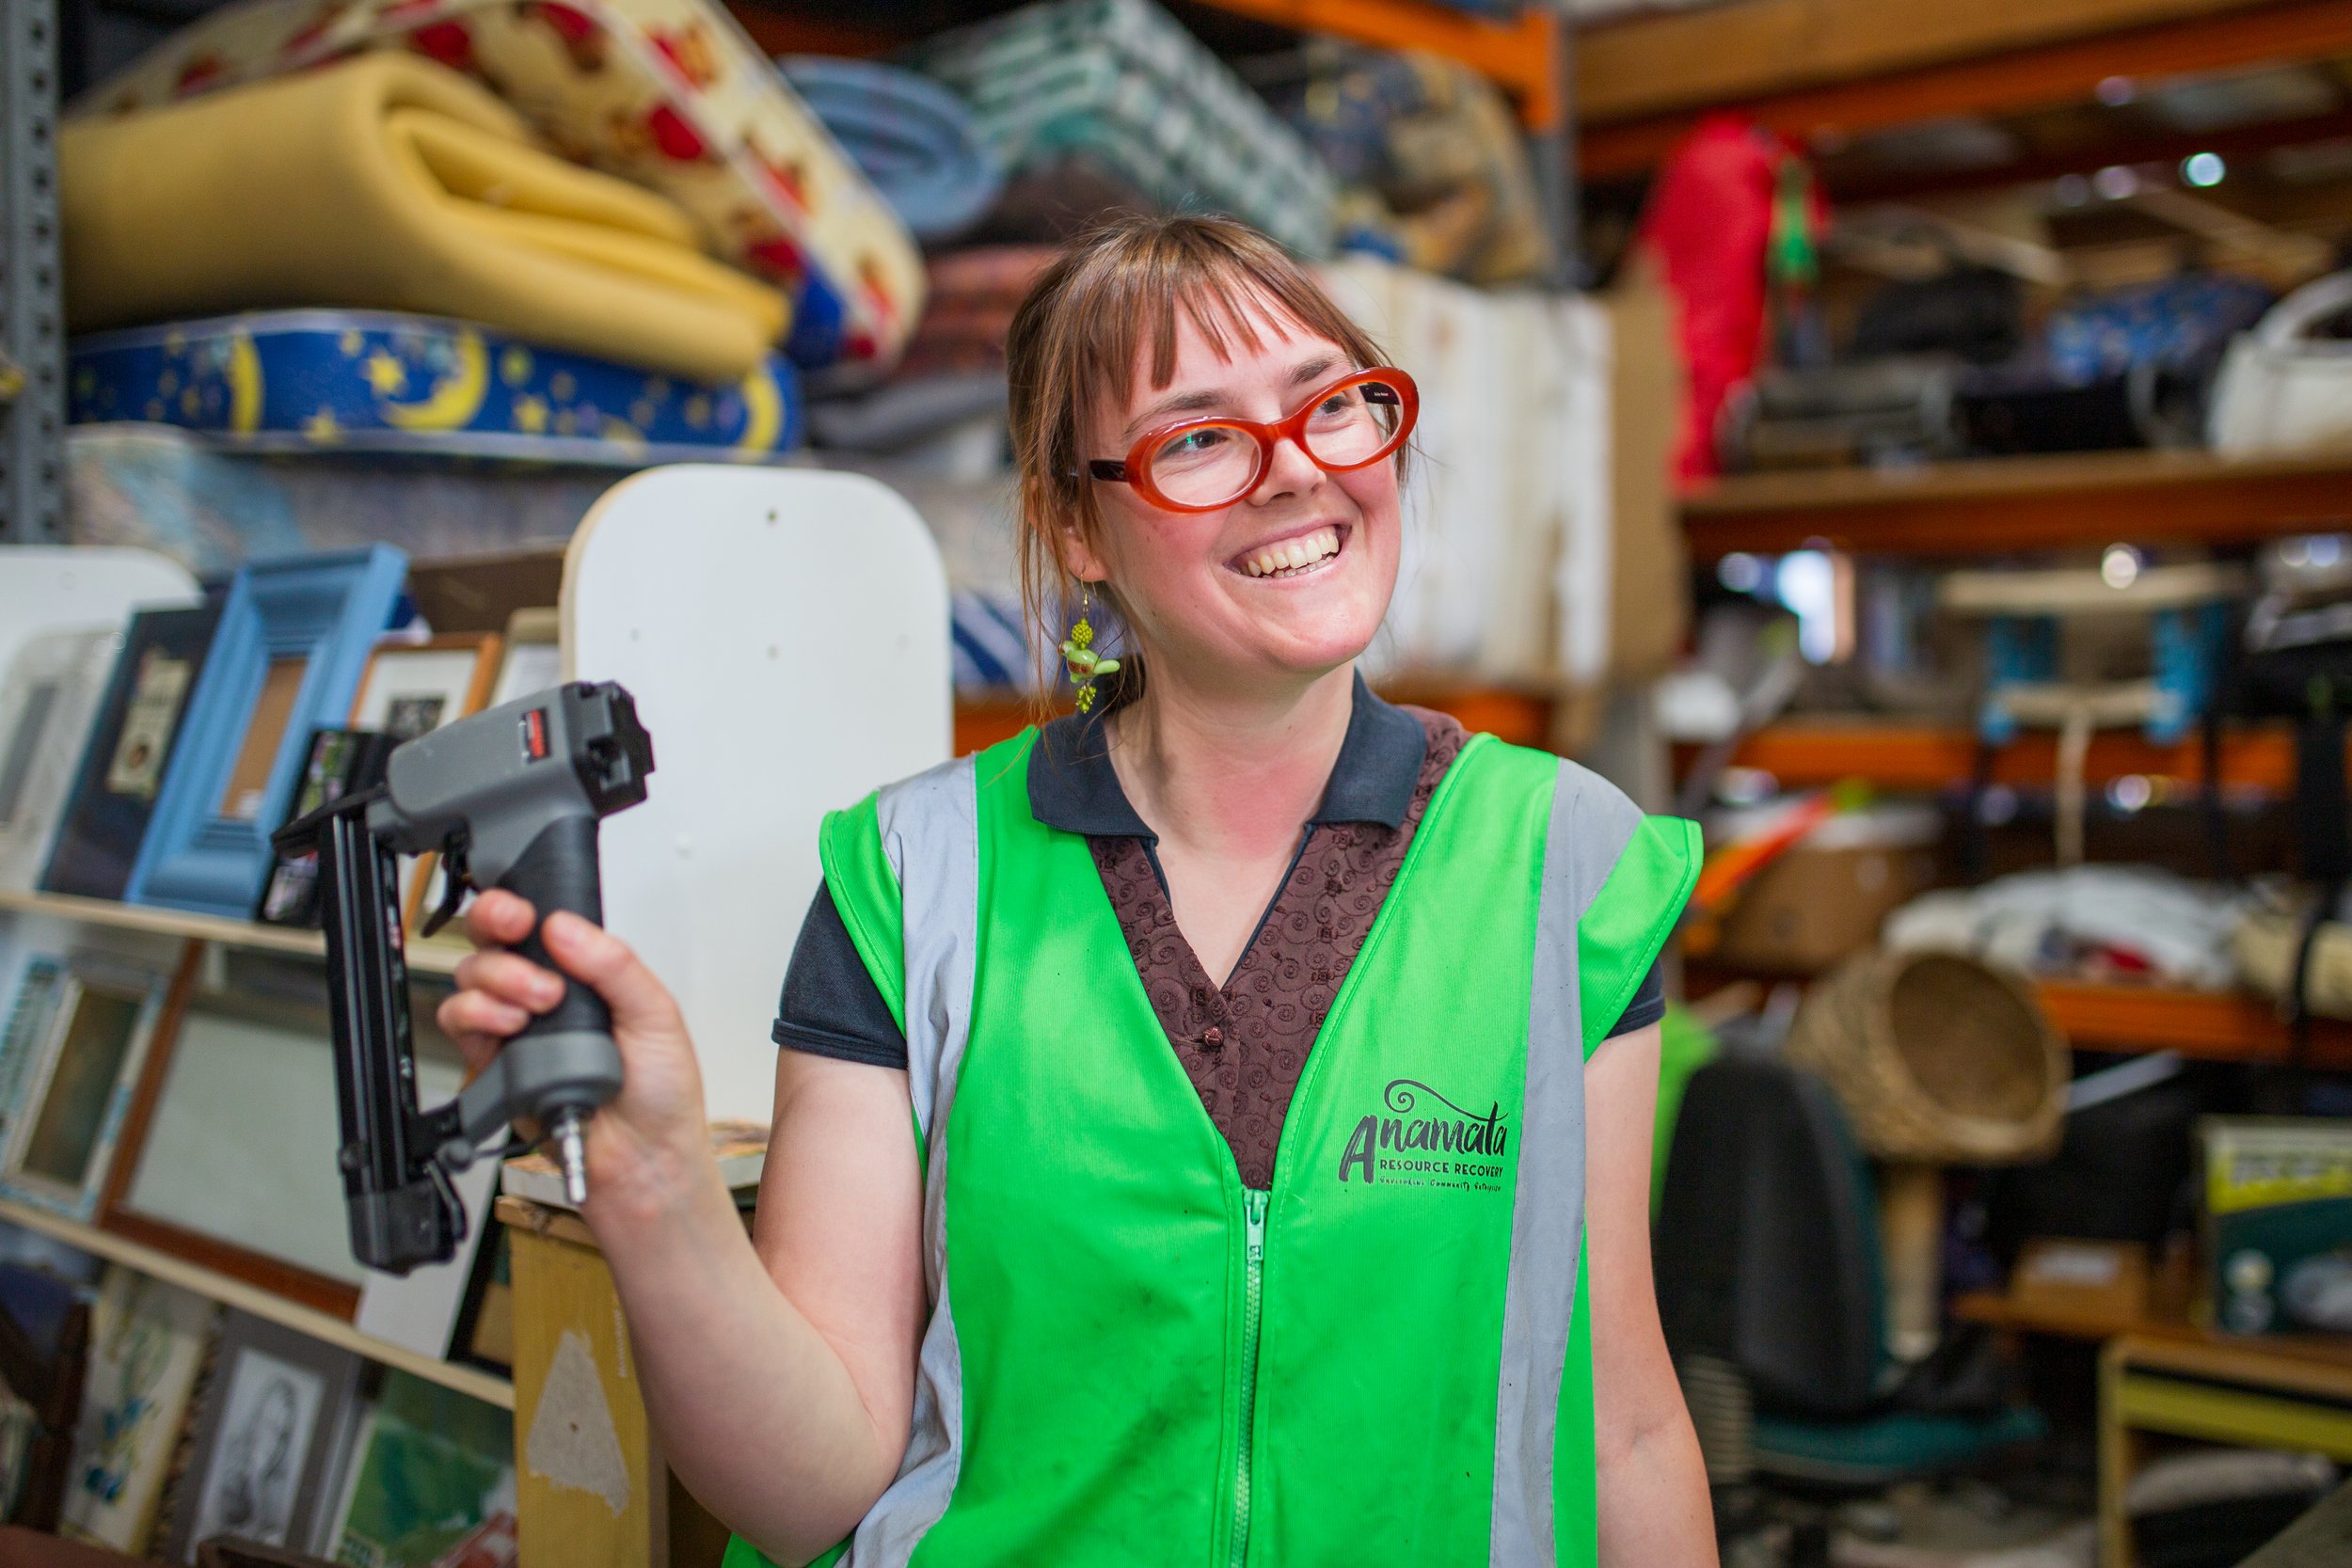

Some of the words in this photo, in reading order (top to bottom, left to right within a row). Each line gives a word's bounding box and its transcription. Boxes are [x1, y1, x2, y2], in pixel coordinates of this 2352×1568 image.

[1339, 1080, 1508, 1184] Anamata
[1380, 1159, 1449, 1173] RESOURCE
[1454, 1164, 1503, 1178] RECOVERY
[1430, 1179, 1470, 1193] Community
